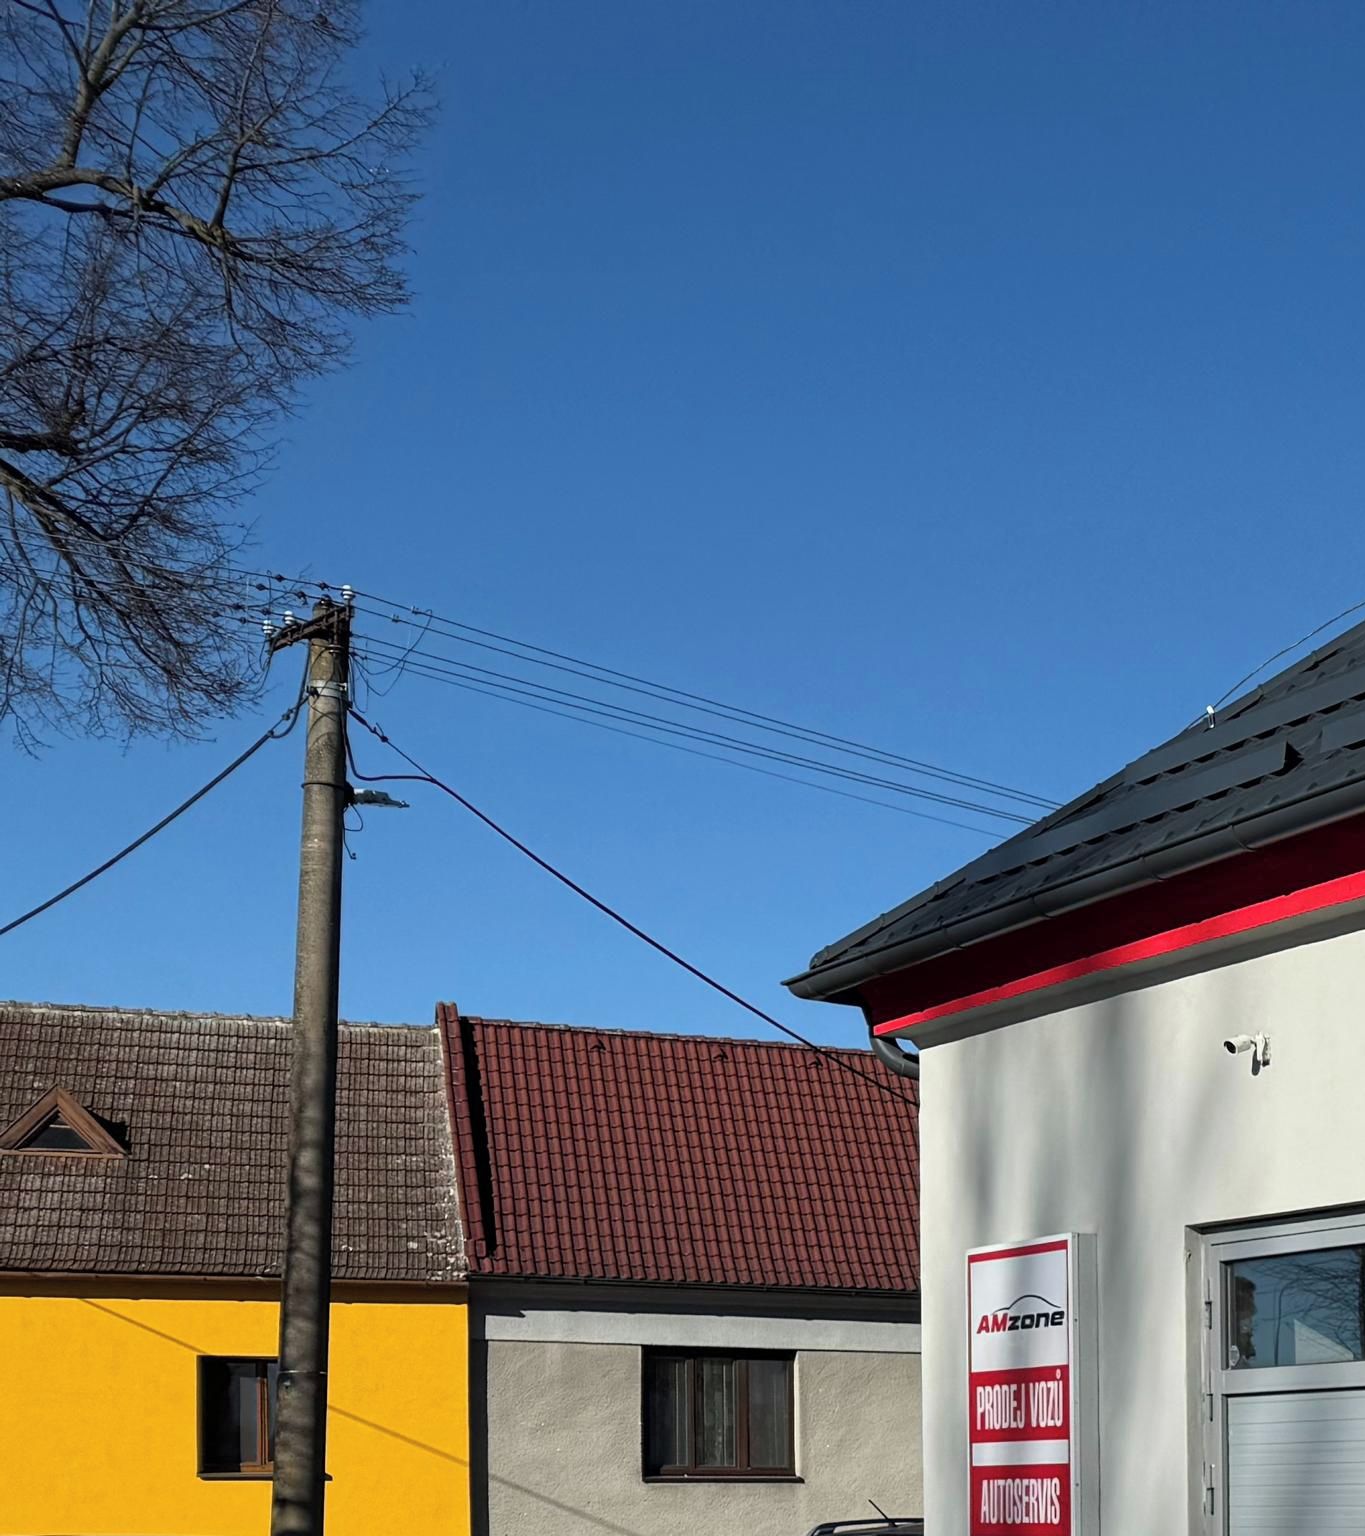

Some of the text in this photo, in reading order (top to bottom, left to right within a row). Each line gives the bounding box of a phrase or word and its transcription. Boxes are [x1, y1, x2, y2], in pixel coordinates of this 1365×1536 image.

[976, 1309, 1065, 1335] AMzone
[975, 1368, 1064, 1431] PRODEJ VOZŮ
[980, 1477, 1061, 1525] AUTOSERVIS
